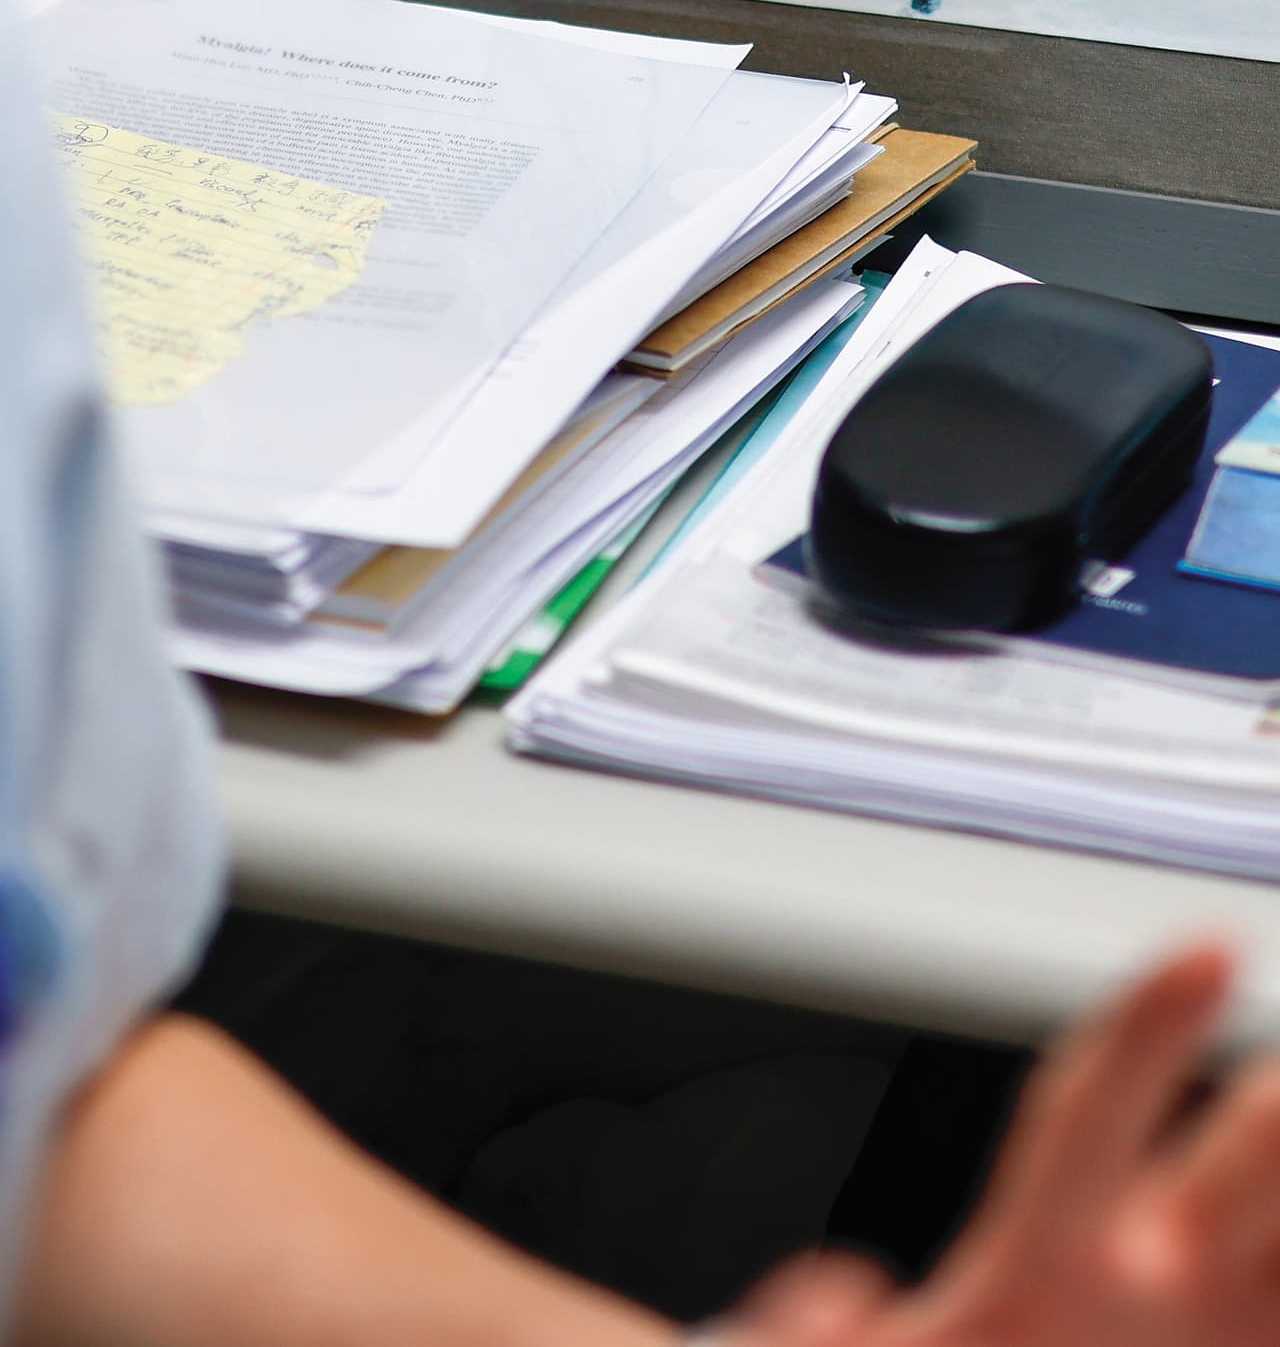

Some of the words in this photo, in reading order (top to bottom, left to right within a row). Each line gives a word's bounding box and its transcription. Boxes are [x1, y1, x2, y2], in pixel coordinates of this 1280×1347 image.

[281, 50, 335, 66] Where
[339, 58, 376, 72] does
[380, 64, 394, 74] it
[397, 70, 442, 81] come
[446, 75, 499, 89] from?
